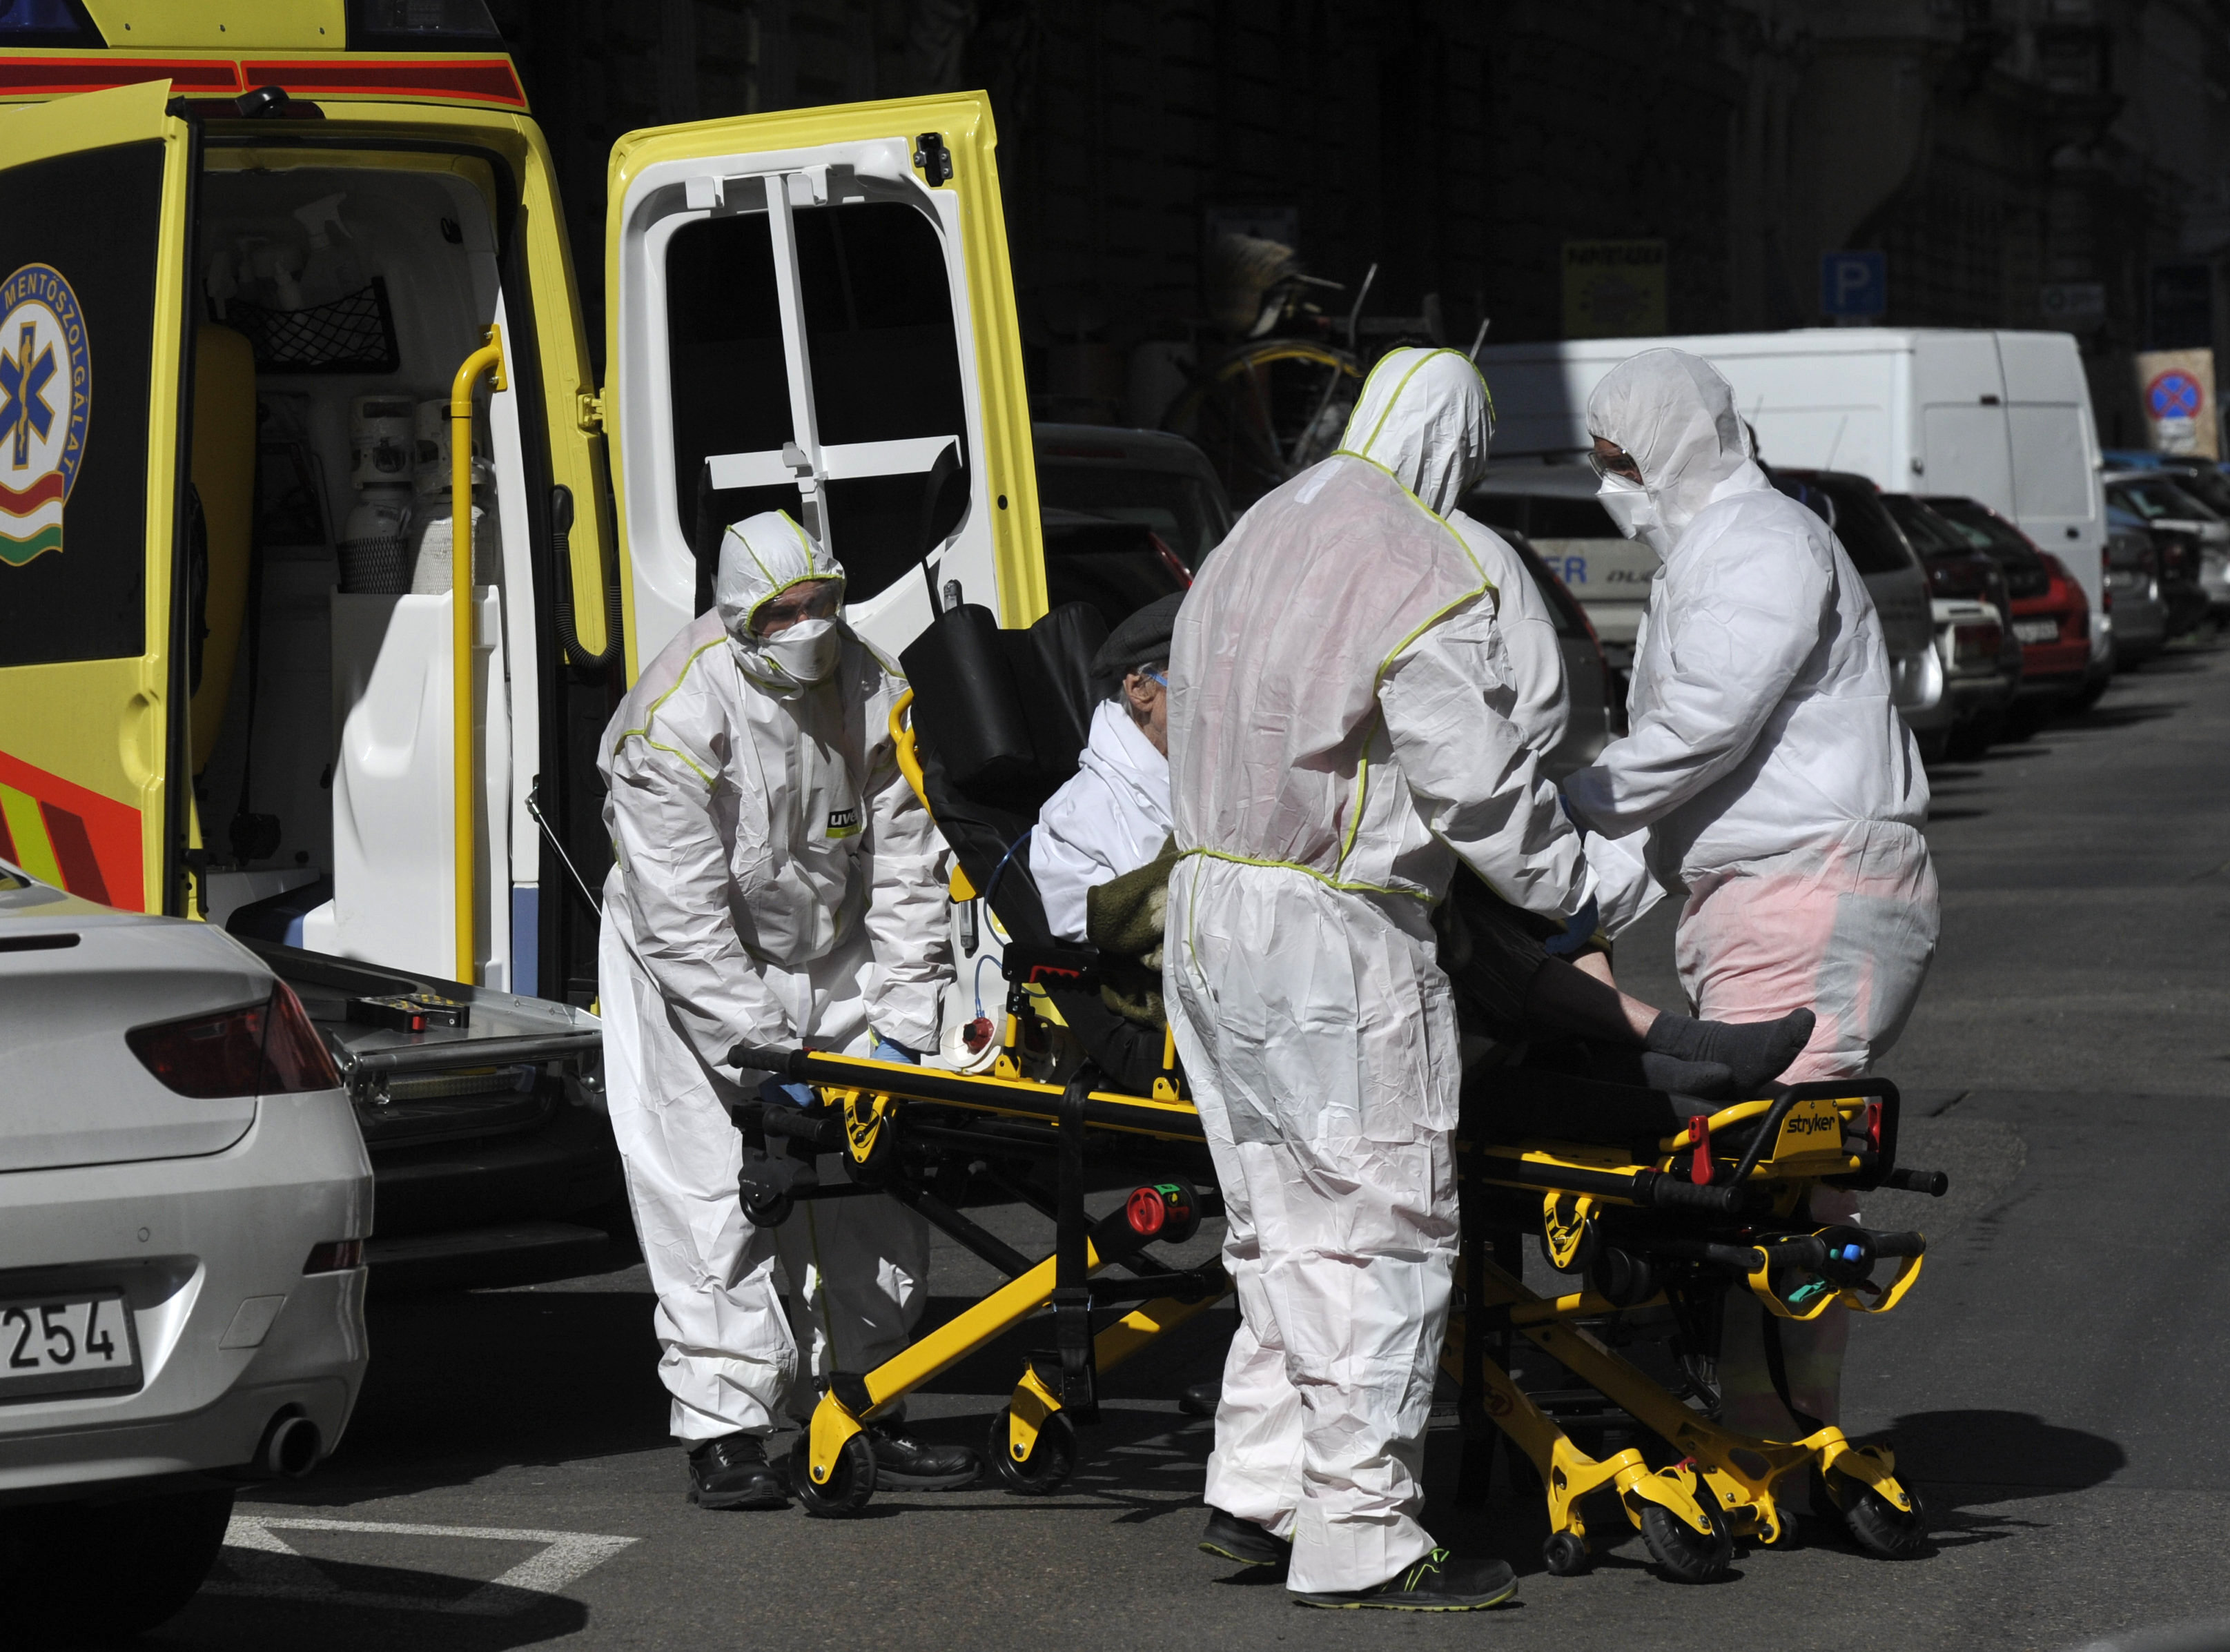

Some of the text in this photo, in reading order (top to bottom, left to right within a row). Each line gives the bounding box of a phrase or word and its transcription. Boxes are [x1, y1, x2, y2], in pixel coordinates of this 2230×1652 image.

[1837, 262, 1871, 307] P
[4, 273, 88, 474] MENTŐSZOLGÁLAT
[1786, 1113, 1835, 1135] stryker
[3, 1300, 115, 1368] 254
